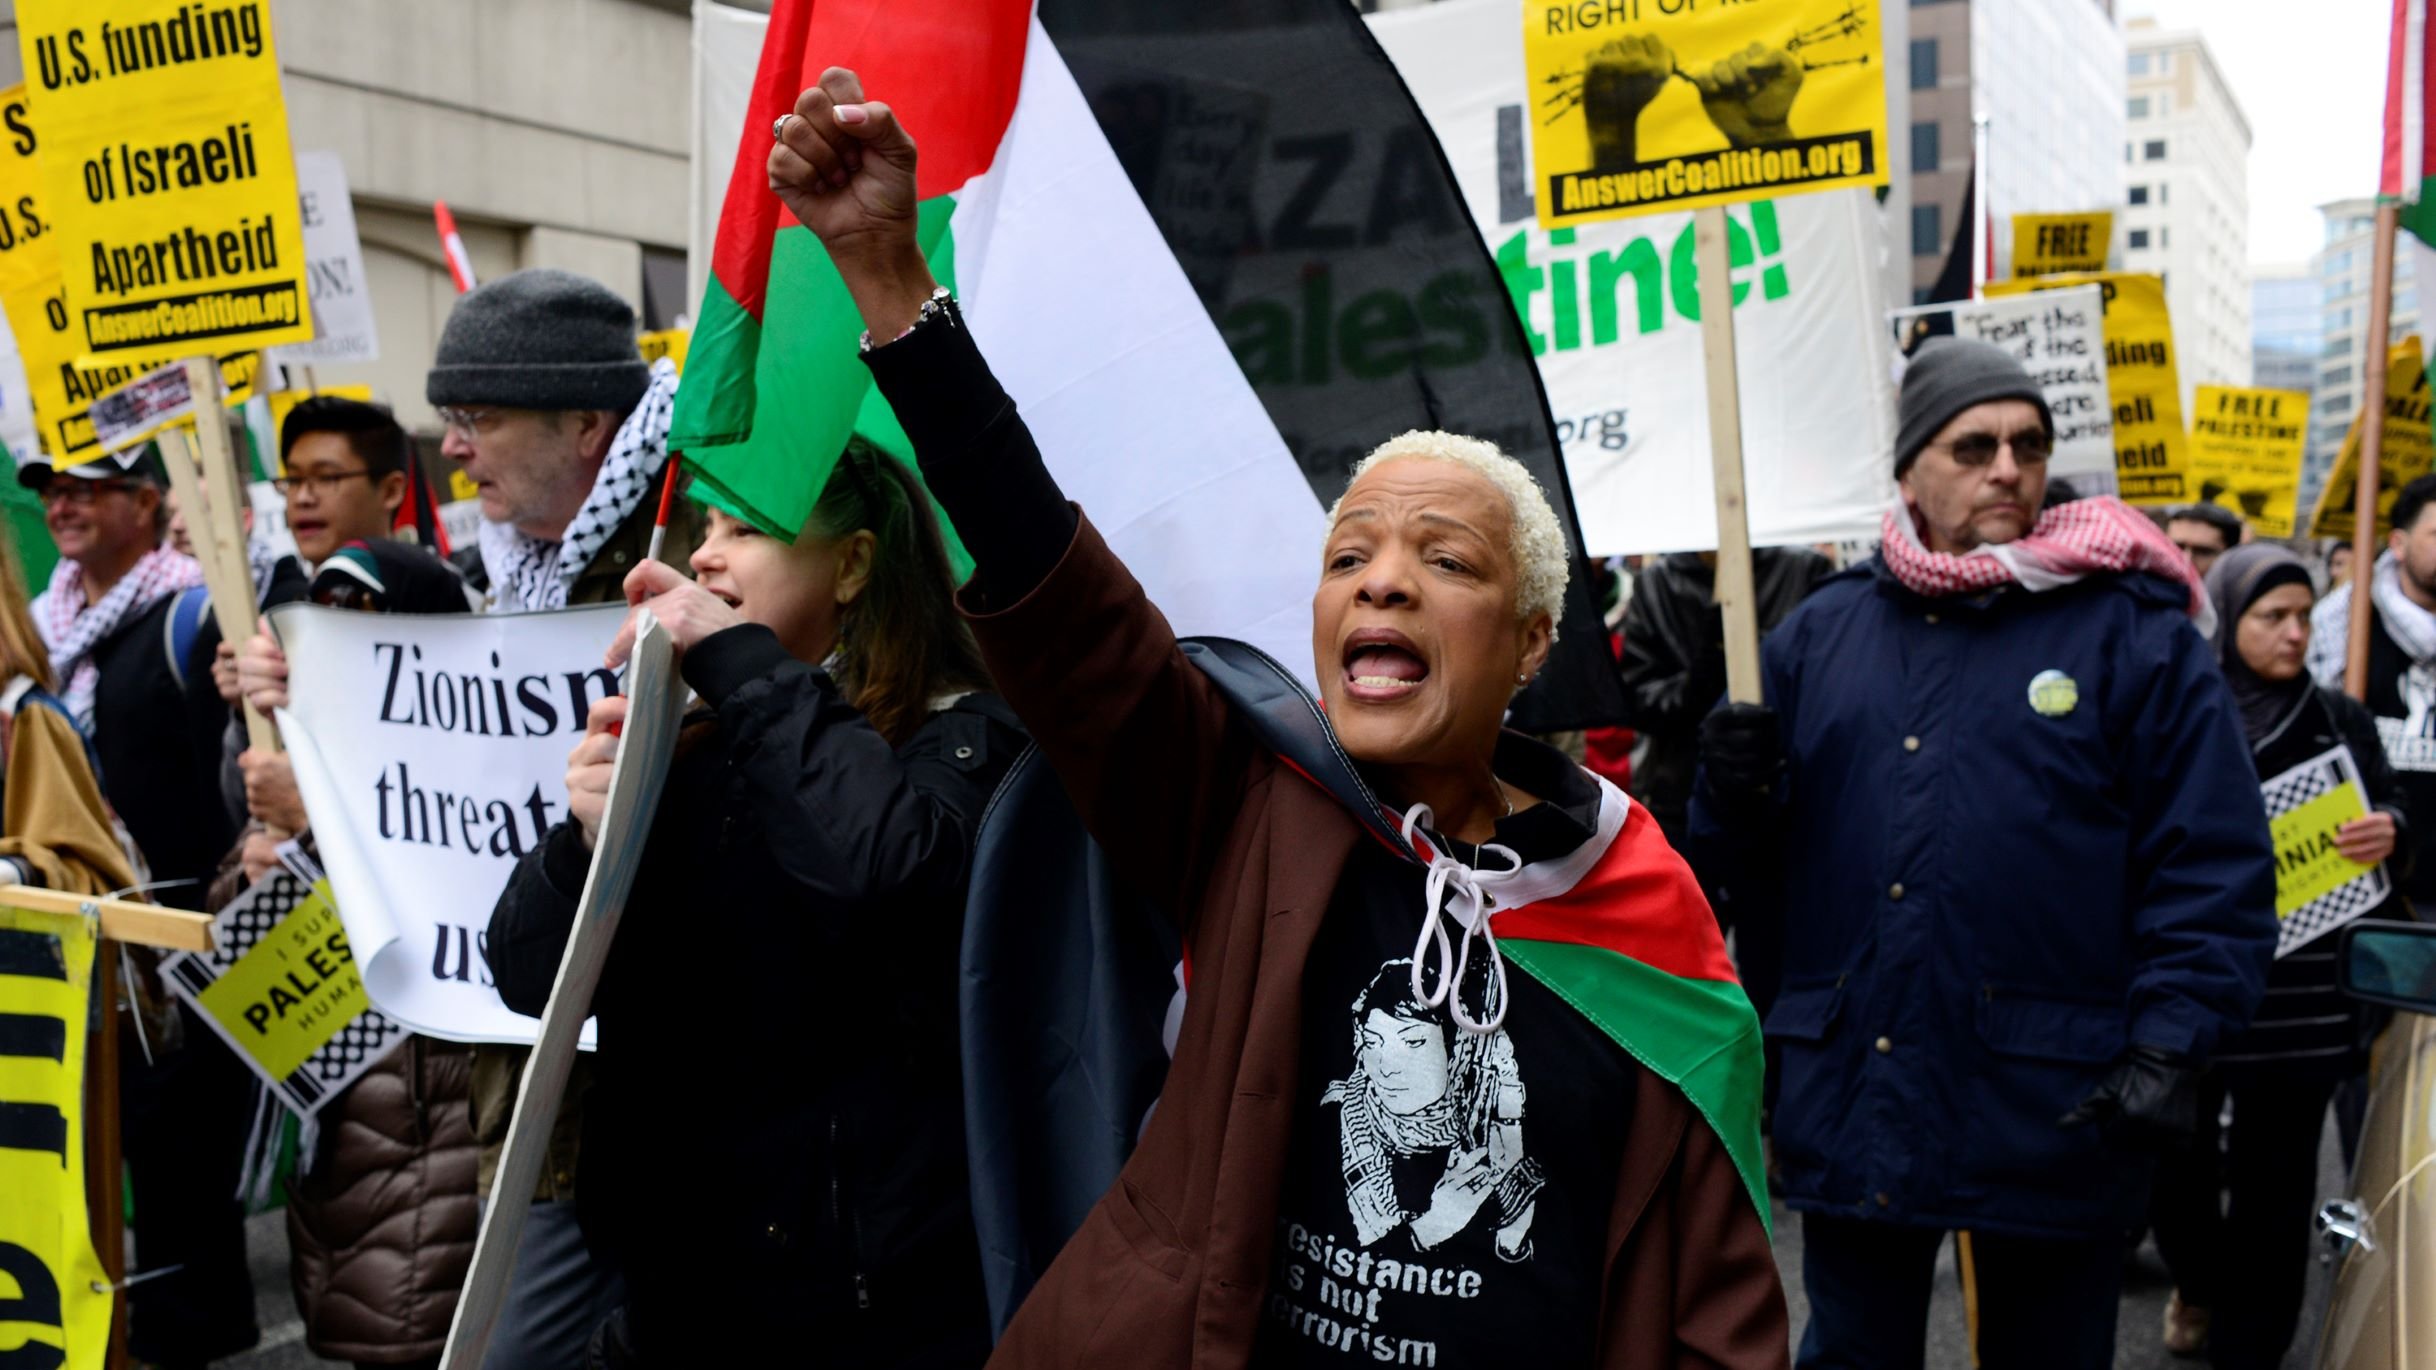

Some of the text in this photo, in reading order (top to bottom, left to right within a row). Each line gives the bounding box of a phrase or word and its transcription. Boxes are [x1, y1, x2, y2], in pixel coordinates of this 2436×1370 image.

[36, 2, 264, 91] U.S. funding
[84, 123, 259, 204] of Israeli
[1562, 139, 1863, 212] AnswerCoalition.org
[91, 215, 279, 296] Apartheid
[2036, 223, 2091, 257] FREE
[89, 286, 298, 347] AnswerCoalition.org
[2105, 341, 2166, 367] ding
[243, 927, 354, 1036] PALES
[1286, 1218, 1483, 1298] esistance
[1320, 1275, 1383, 1324] not
